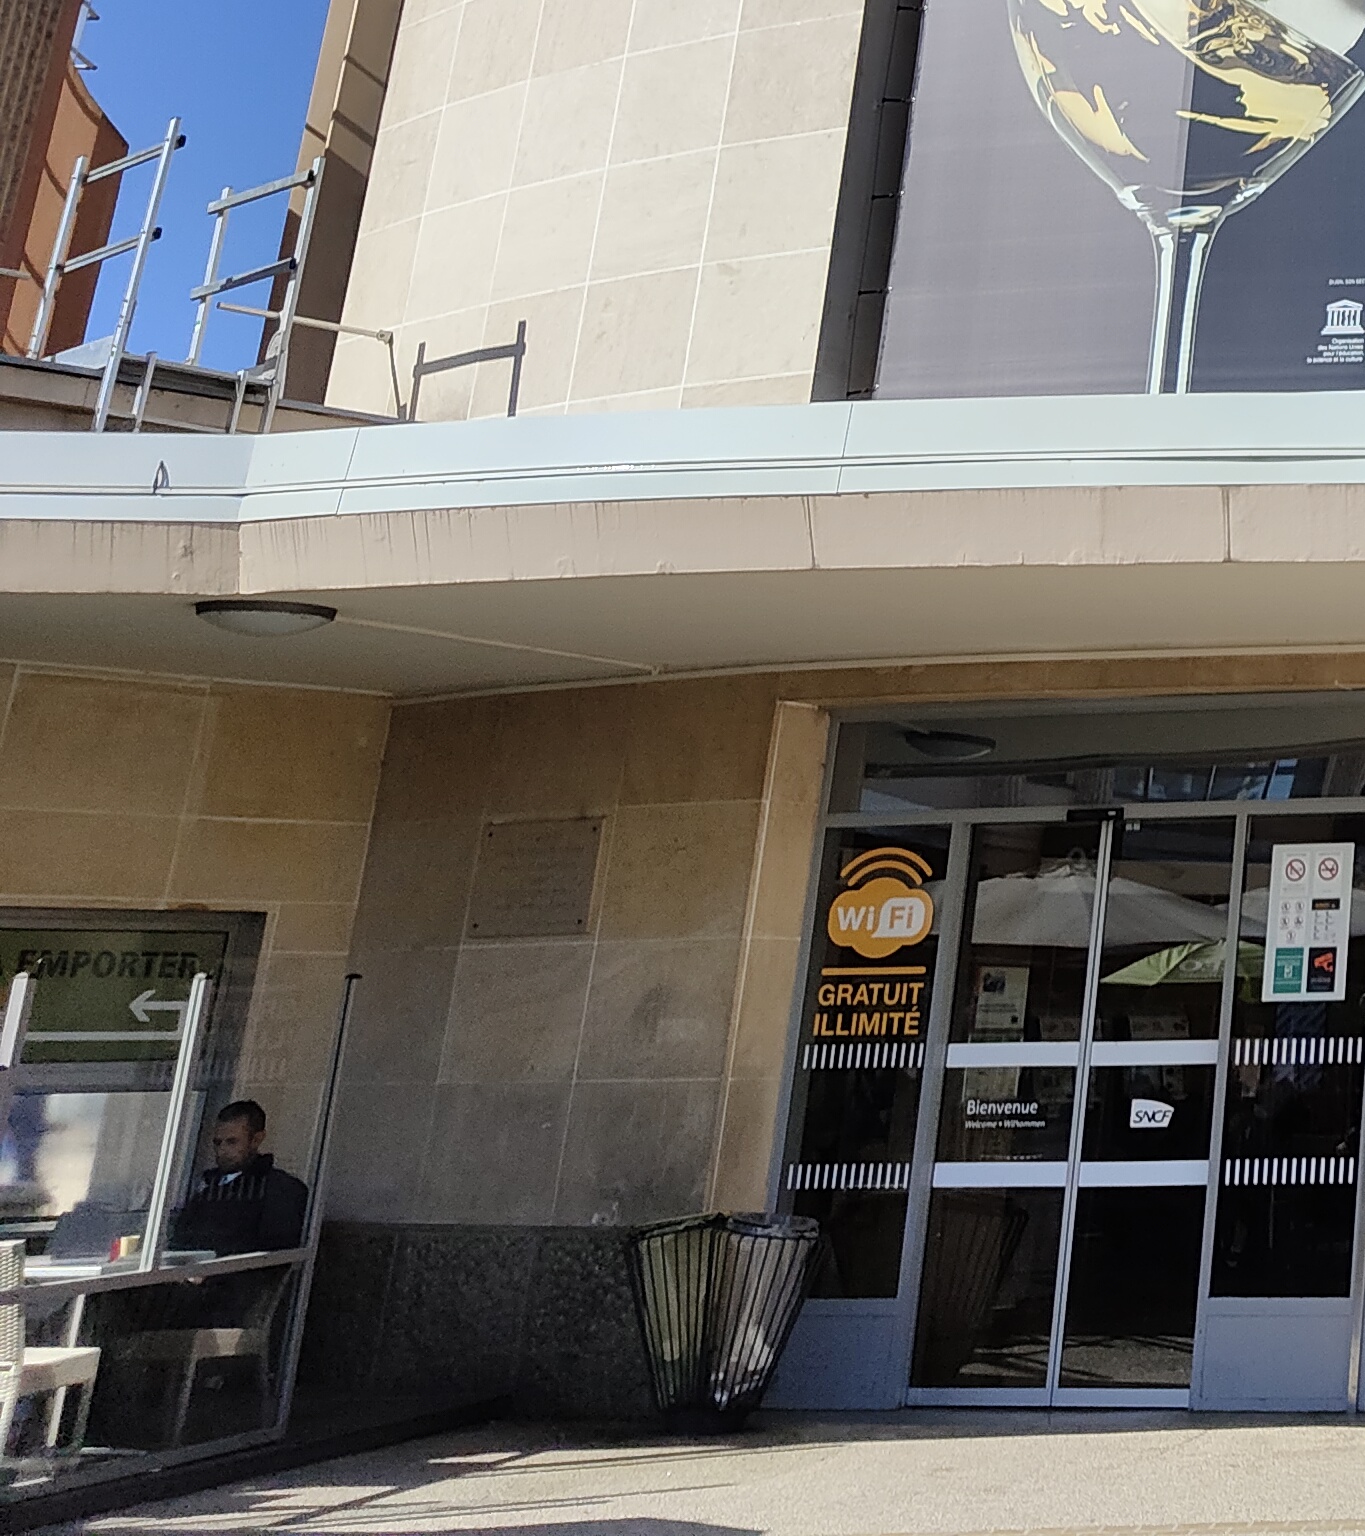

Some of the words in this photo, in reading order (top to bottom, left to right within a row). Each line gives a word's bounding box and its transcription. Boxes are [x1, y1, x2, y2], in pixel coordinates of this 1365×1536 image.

[15, 949, 213, 980] EMPORTER
[818, 982, 925, 1006] GRATUIT
[812, 1006, 921, 1037] ILLIMITÉ
[966, 1099, 1039, 1116] Bienvenue
[1132, 1109, 1173, 1124] SNCF
